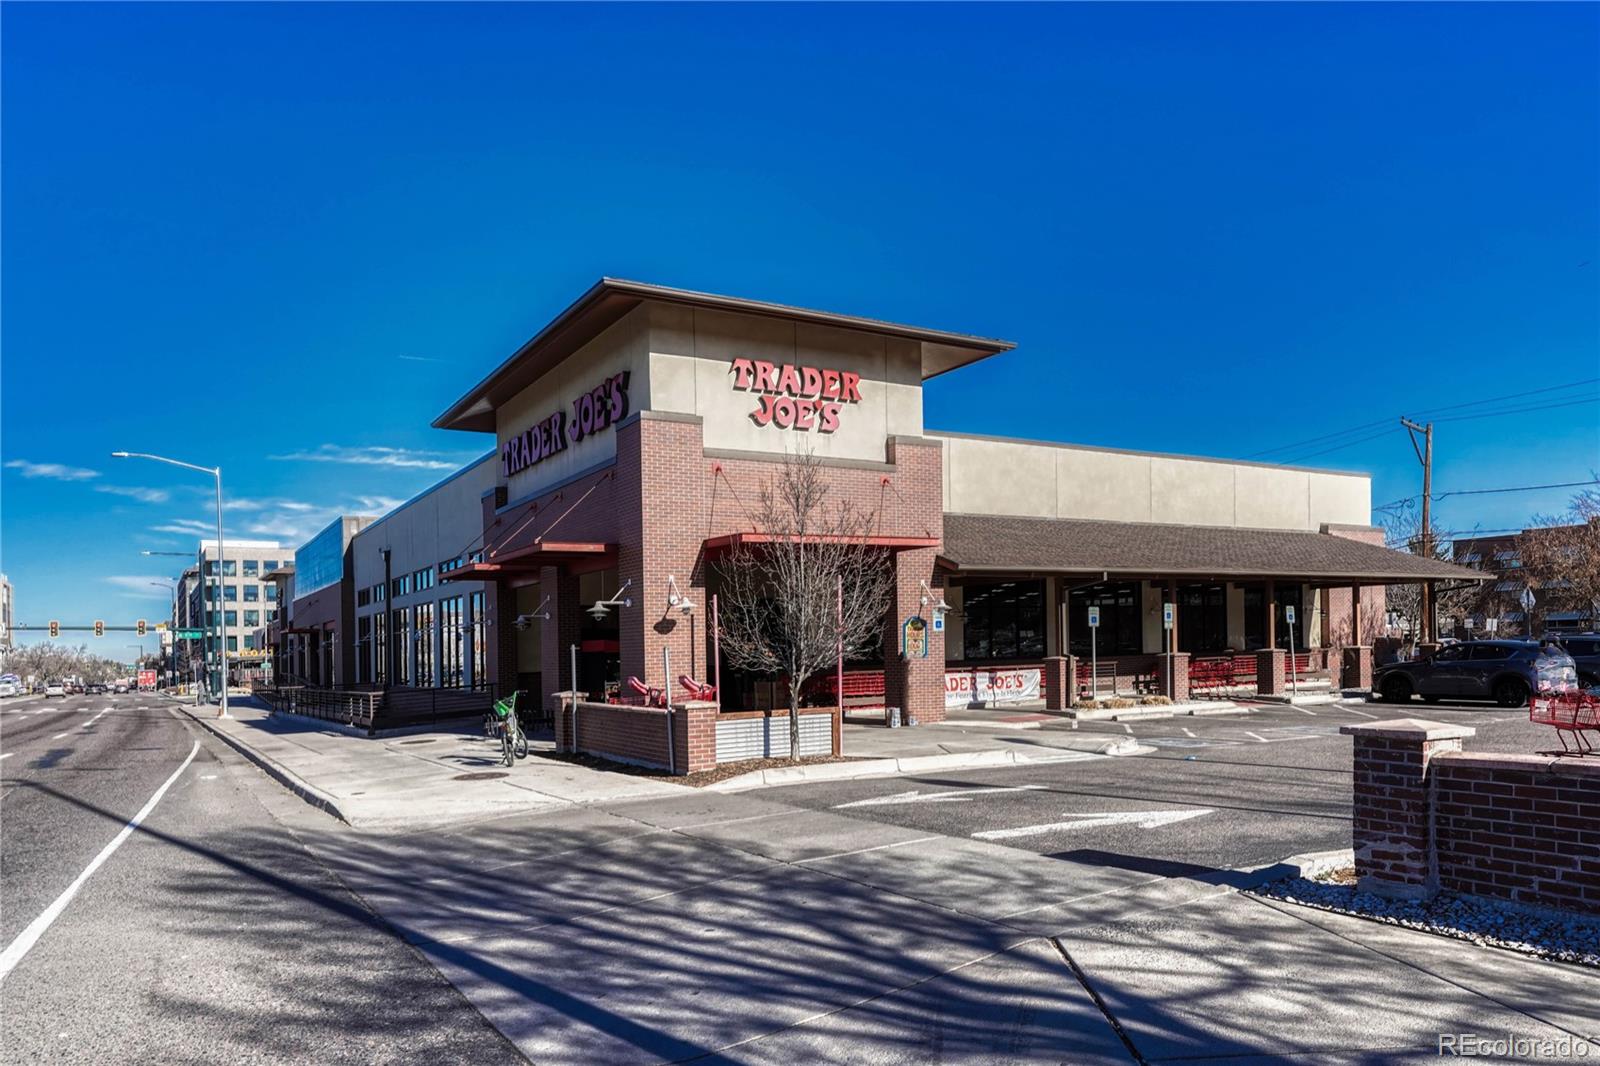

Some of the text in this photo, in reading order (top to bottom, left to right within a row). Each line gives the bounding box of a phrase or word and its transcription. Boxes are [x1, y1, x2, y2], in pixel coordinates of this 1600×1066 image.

[728, 358, 863, 404] TRADER
[502, 370, 631, 478] TRADER JOE'S
[748, 395, 843, 434] JOE'S
